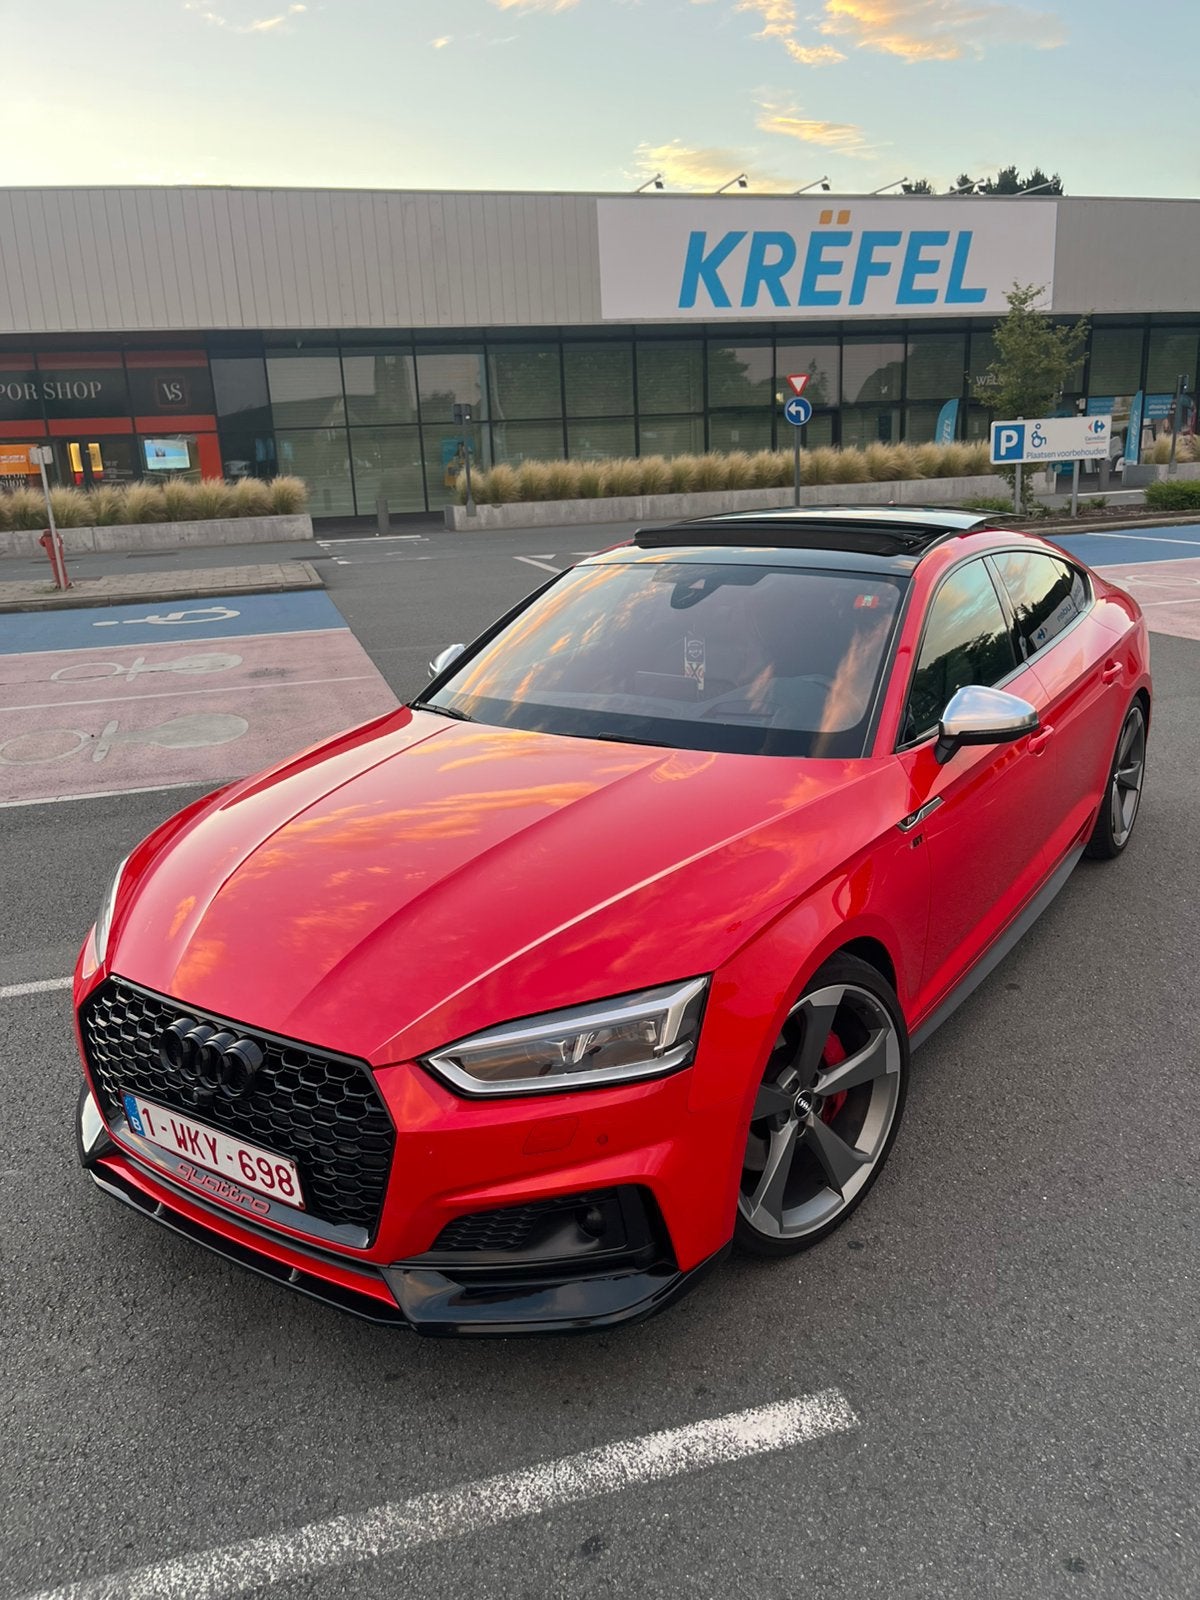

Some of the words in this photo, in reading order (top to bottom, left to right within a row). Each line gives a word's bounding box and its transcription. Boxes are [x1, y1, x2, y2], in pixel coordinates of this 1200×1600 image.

[678, 209, 988, 308] KRËFEL
[43, 381, 102, 400] SHOP
[162, 382, 183, 401] VS
[1000, 430, 1018, 456] P
[1026, 451, 1056, 459] Plaatsen
[1057, 448, 1107, 457] voorbehouden
[131, 1116, 142, 1131] B
[142, 1108, 295, 1197] 1-WKY-698
[177, 1163, 271, 1214] quattro
